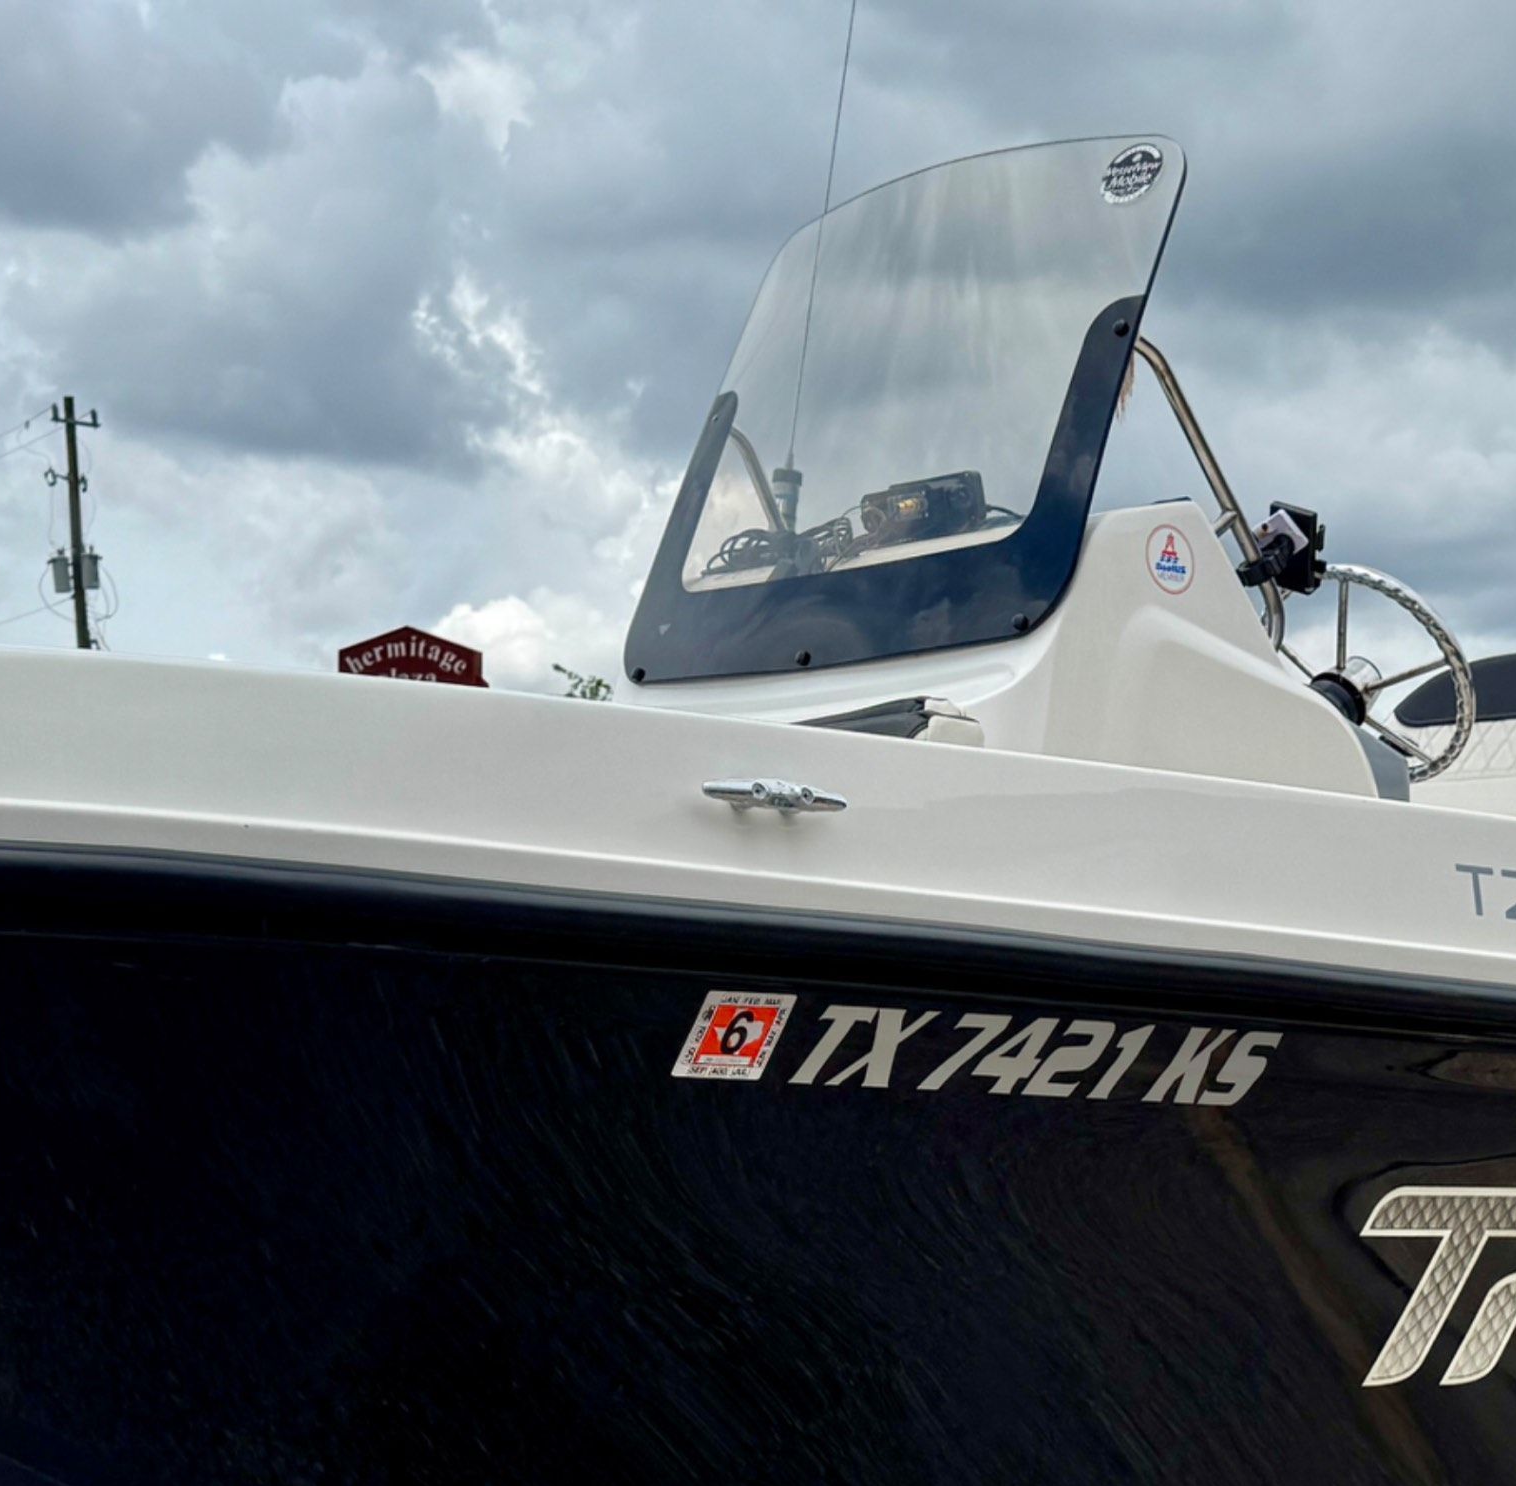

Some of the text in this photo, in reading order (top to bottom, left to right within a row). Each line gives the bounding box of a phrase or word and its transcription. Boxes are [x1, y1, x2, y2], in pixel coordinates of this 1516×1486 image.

[1108, 174, 1152, 189] Mobile
[345, 636, 468, 675] hermitage
[720, 1010, 754, 1055] 6
[788, 1005, 1284, 1107] TX 7421 KS
